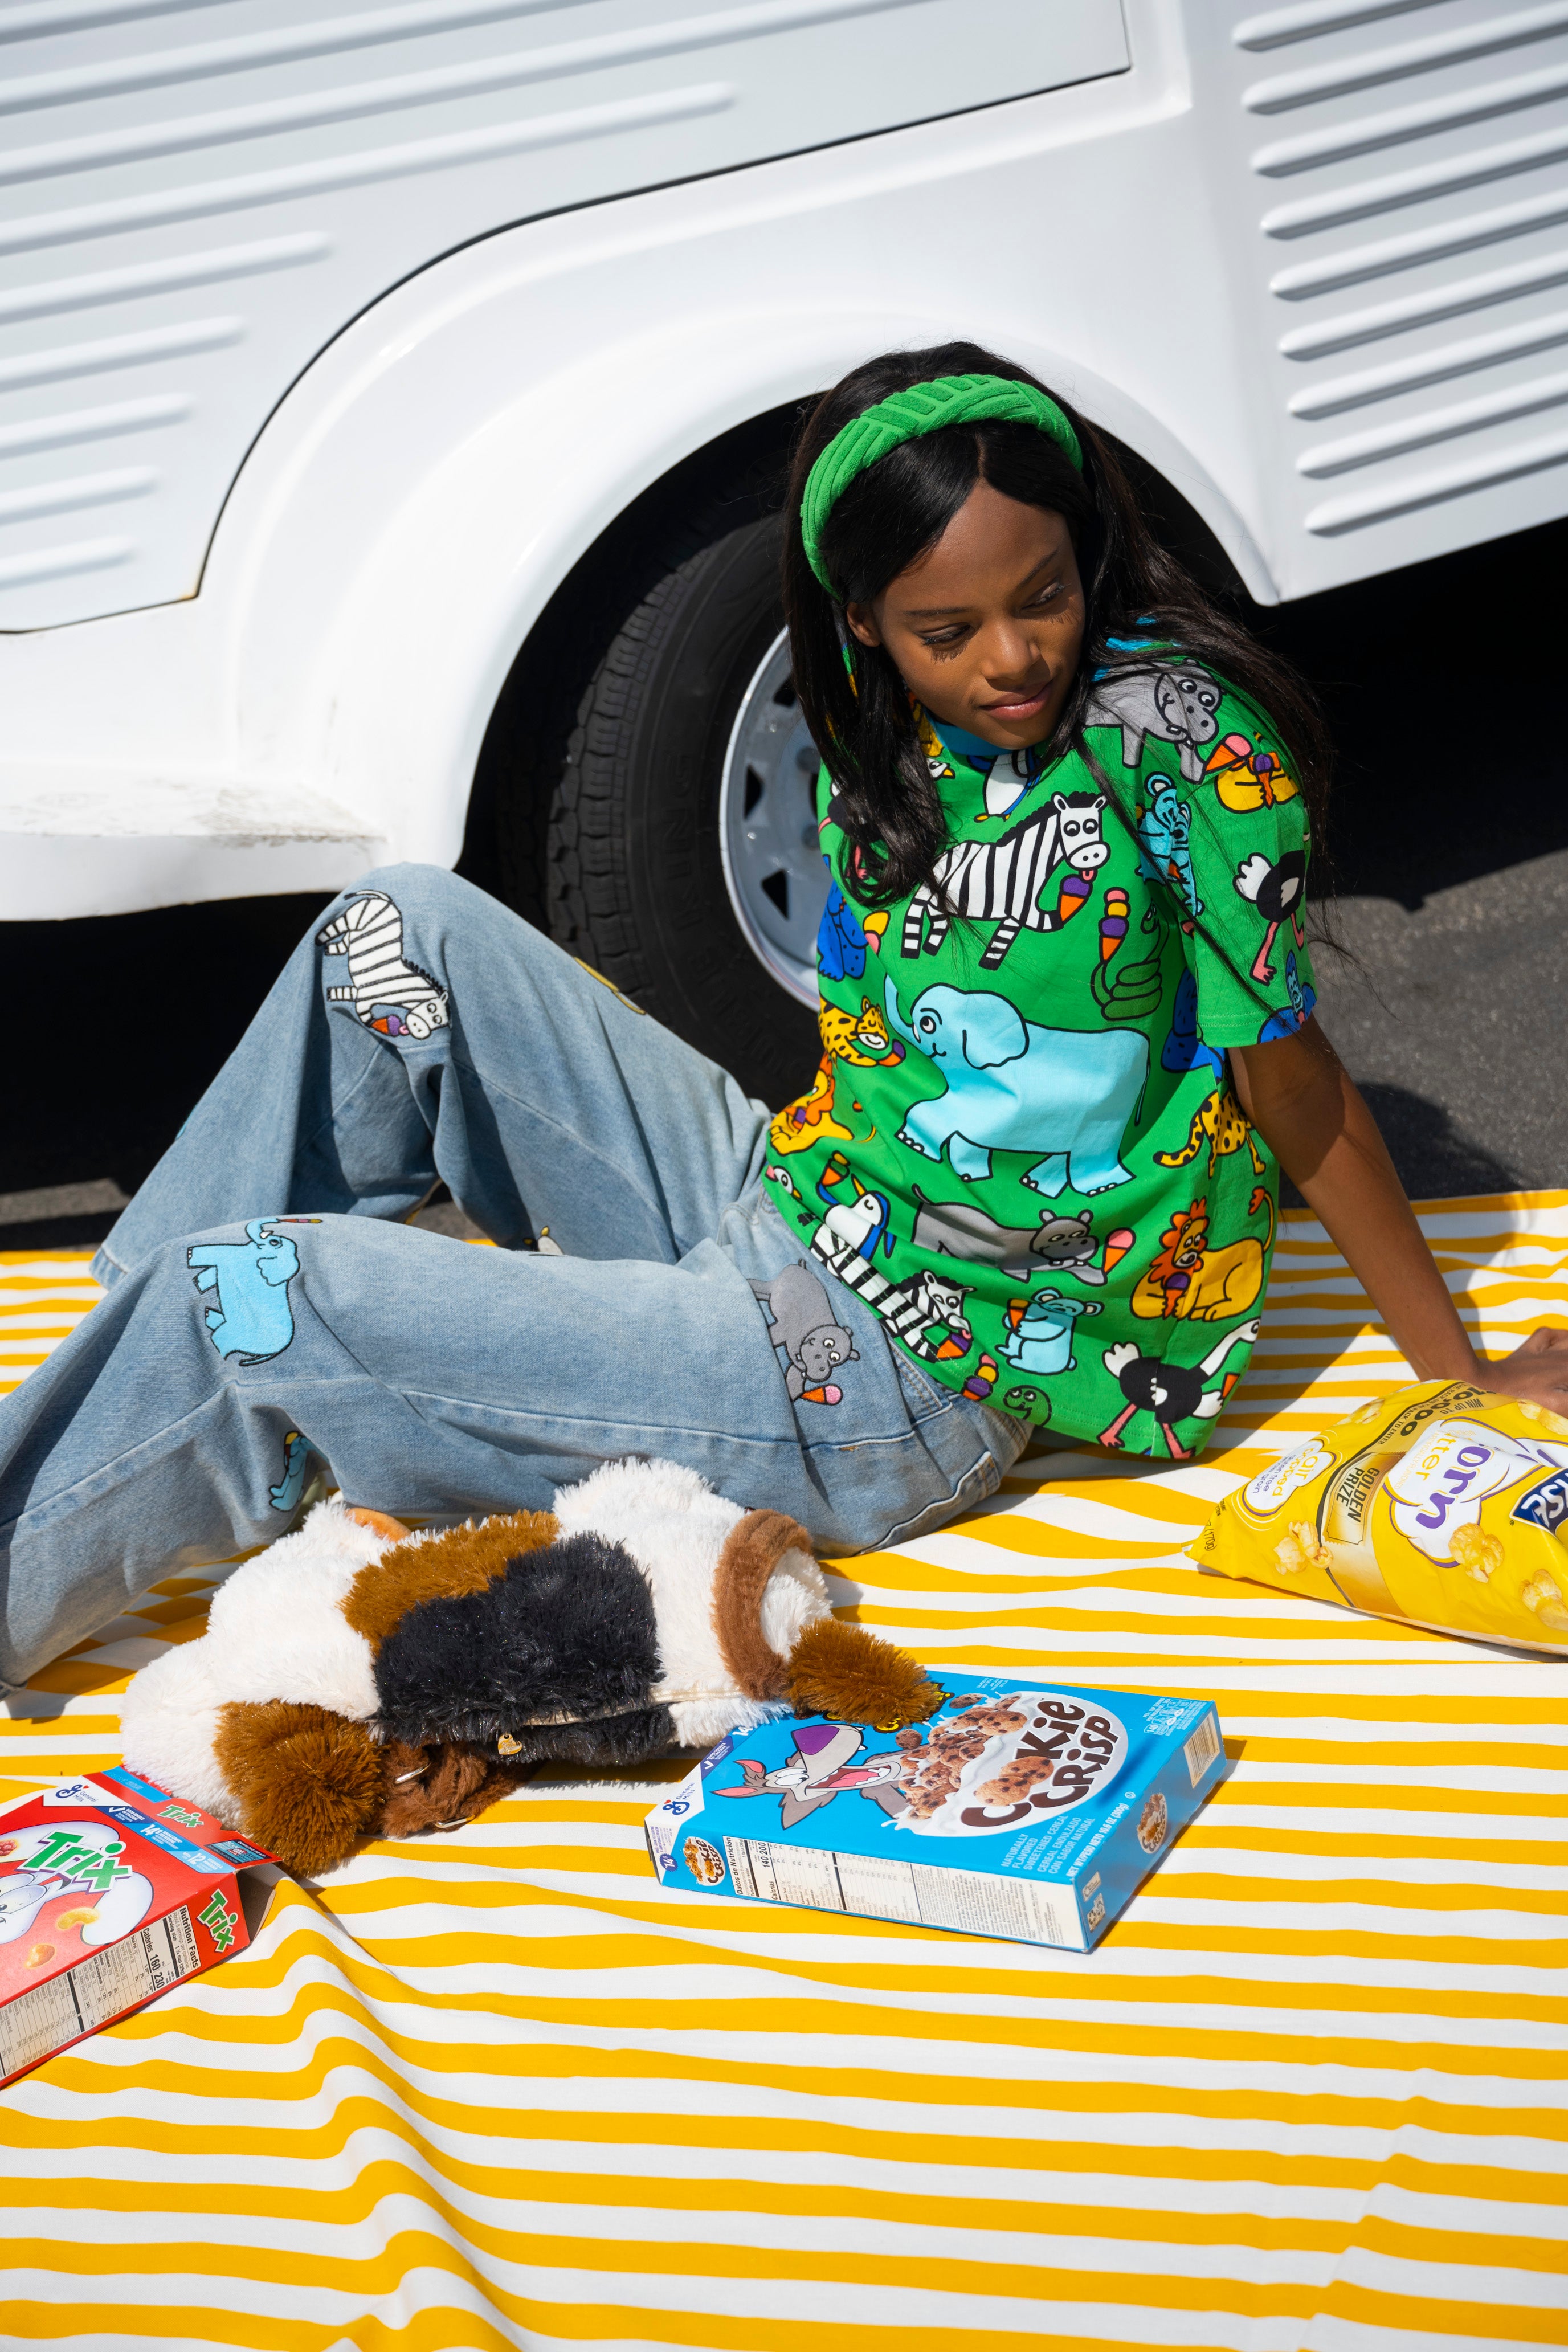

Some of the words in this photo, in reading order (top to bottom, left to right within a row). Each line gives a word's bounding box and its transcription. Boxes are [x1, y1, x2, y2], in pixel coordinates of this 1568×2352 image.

[1440, 1389, 1456, 1400] BACK
[1468, 1398, 1484, 1408] WIN
[1400, 1387, 1496, 1436] 10,000
[1404, 1408, 1418, 1420] PACK
[1455, 1401, 1467, 1410] UP
[1394, 1419, 1404, 1430] TO
[1378, 1429, 1396, 1444] ENTER
[1295, 1456, 1318, 1480] air
[1263, 1475, 1277, 1492] free
[1336, 1467, 1365, 1508] PRIZE
[1348, 1467, 1381, 1523] GOLDEN
[80, 1791, 98, 1802] General
[676, 1782, 695, 1800] General
[683, 1789, 696, 1800] Mills
[156, 1804, 204, 1828] Trix
[1109, 1803, 1132, 1818] (300g)
[1097, 1824, 1112, 1833] 10.6
[758, 1842, 767, 1854] 200
[1022, 1835, 1054, 1869] SWEETENED
[1047, 1815, 1067, 1834] CEREAL
[1035, 1849, 1059, 1871] CEREAL
[1052, 1817, 1081, 1848] ENDULZADO
[1047, 1860, 1064, 1873] CON
[1056, 1841, 1077, 1859] SABOR
[1071, 1818, 1095, 1840] NATURAL
[1088, 1834, 1106, 1845] NETO
[187, 1853, 206, 1864] 12
[725, 1838, 736, 1865] Nutrición
[1000, 1834, 1030, 1866] NATURALLY
[1011, 1838, 1039, 1868] FLAVORED
[1072, 1845, 1096, 1865] WT/PESO
[19, 1830, 132, 1892] Trix
[761, 1856, 770, 1867] 140
[1065, 1867, 1080, 1876] NET
[734, 1877, 742, 1893] Datos
[767, 1881, 777, 1899] Calorías
[197, 1889, 238, 1953] Trix
[143, 1928, 154, 1952] Calories
[180, 1907, 193, 1943] Nutrition
[189, 1945, 199, 1968] Facts
[150, 1954, 160, 1970] 160
[154, 1971, 164, 1988] 230
